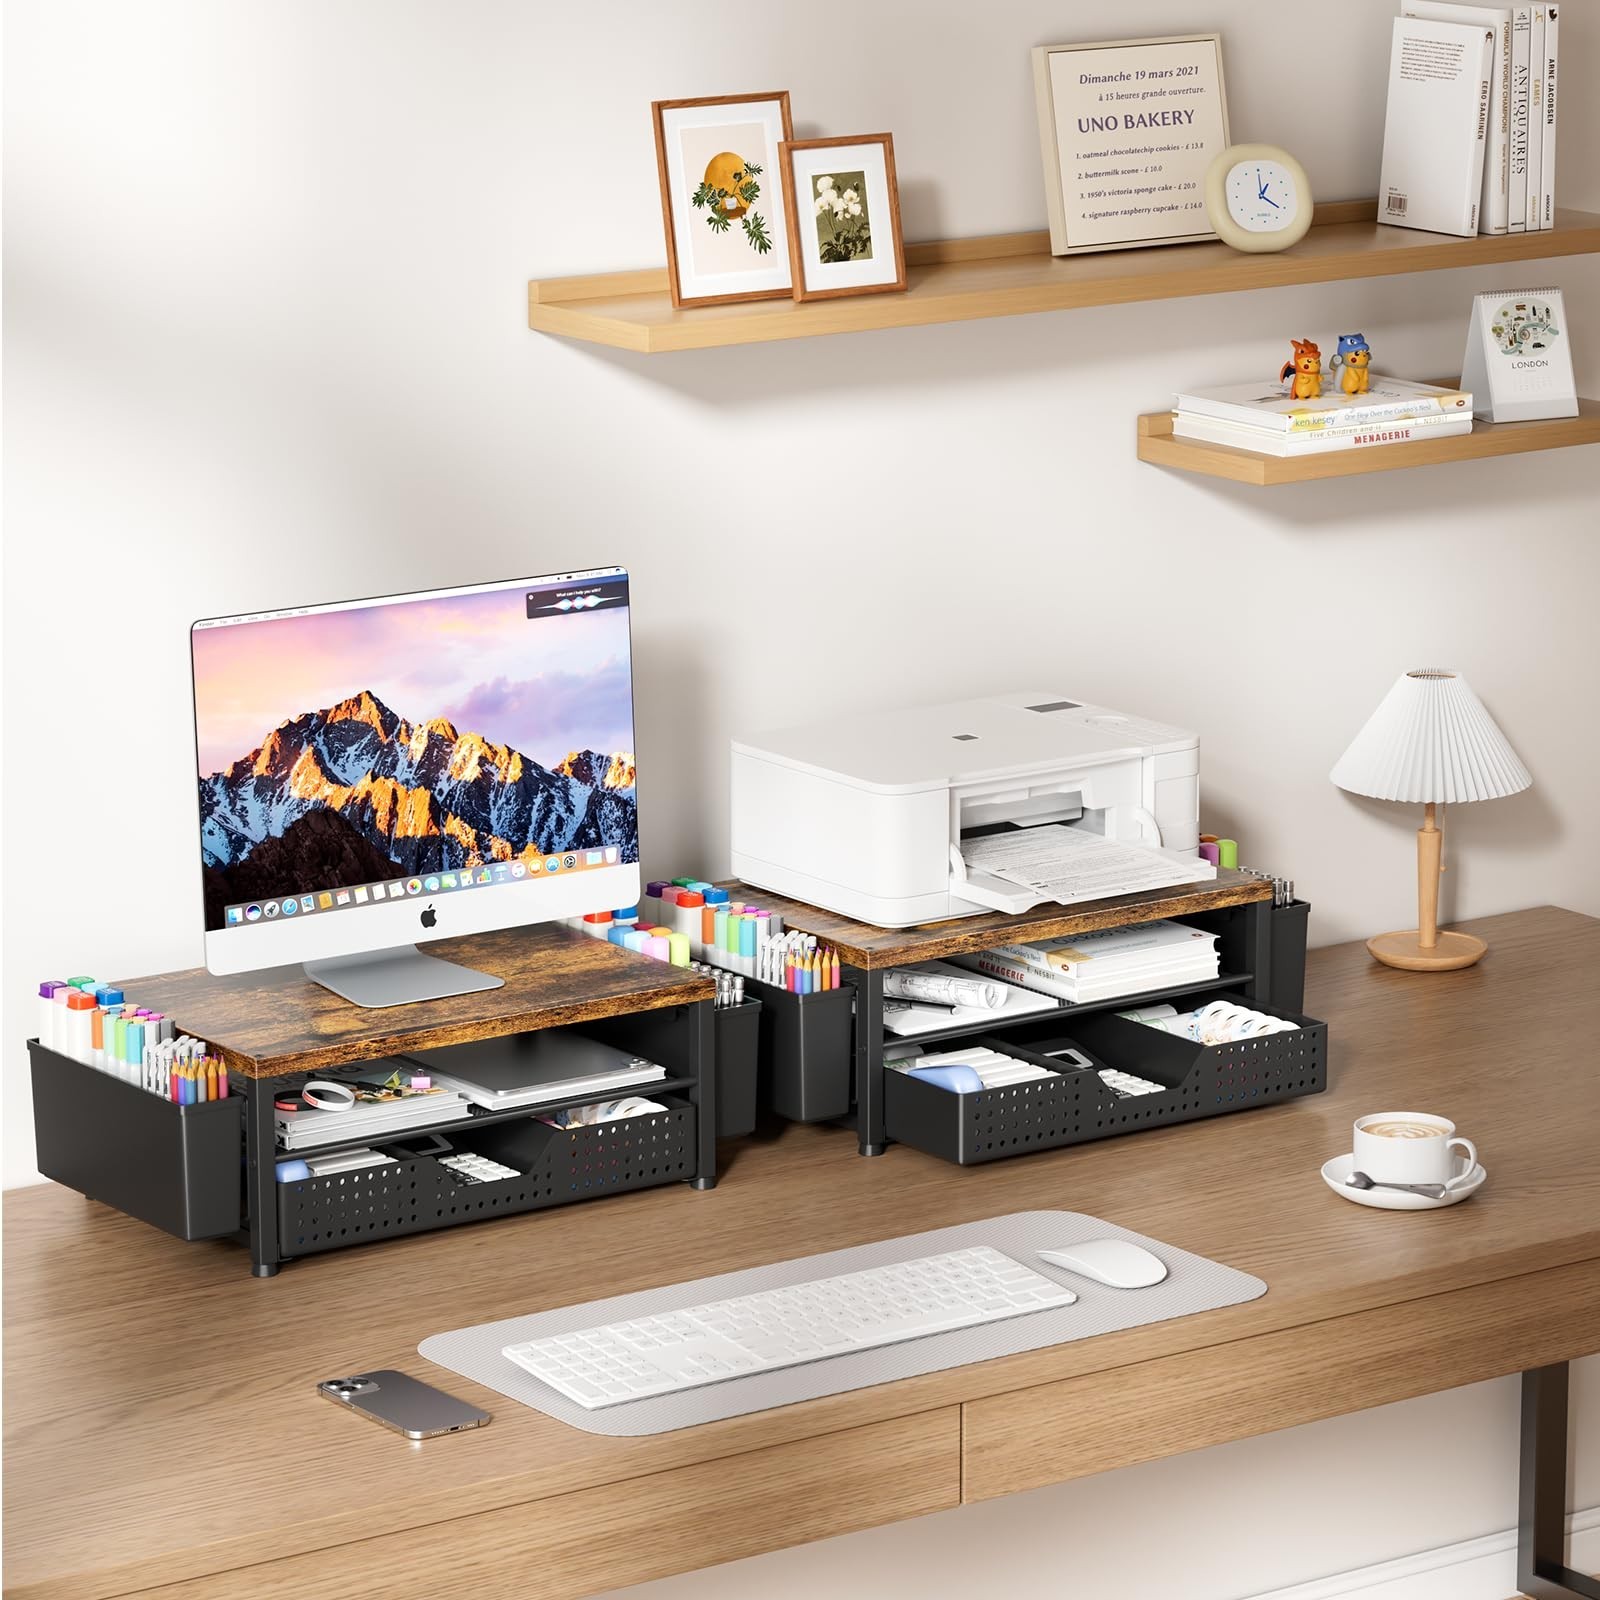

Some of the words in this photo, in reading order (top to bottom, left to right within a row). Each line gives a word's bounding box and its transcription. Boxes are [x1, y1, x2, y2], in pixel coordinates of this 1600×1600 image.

[1079, 71, 1132, 85] Dimanche
[1135, 70, 1146, 80] 19
[1149, 68, 1174, 79] mars
[1176, 65, 1199, 77] 2021
[1105, 93, 1114, 101] 15
[1116, 91, 1140, 100] heures
[1141, 88, 1166, 100] grande
[1168, 86, 1206, 96] ouverture.
[1078, 115, 1118, 133] UNO
[1124, 109, 1195, 129] BAKERY
[1477, 102, 1487, 140] SAARINEN
[1516, 65, 1528, 174] ANTIQUAIRES
[1082, 150, 1109, 159] oatmeal
[1110, 146, 1154, 157] chocolatechip
[1155, 144, 1180, 152] cookies
[1084, 168, 1119, 179] buttermilk
[1120, 167, 1139, 175] scone
[1087, 189, 1107, 199] 1950's
[1108, 187, 1133, 197] victoria
[1134, 185, 1156, 195] sponge
[1157, 182, 1172, 191] cake
[1183, 182, 1196, 190] 20.0
[1088, 210, 1119, 220] signature
[1120, 206, 1151, 217] raspberry
[1152, 204, 1179, 214] cupcake
[1190, 201, 1203, 209] 14.0
[1511, 360, 1549, 369] LONDON
[1295, 418, 1310, 427] ken
[1312, 415, 1336, 425] kesey
[1327, 428, 1357, 436] Children
[1354, 429, 1410, 445] MENAGERIE
[1009, 947, 1030, 959] Cuckoo's
[1030, 953, 1041, 962] Nest
[978, 960, 1025, 982] MENAGERIE
[1034, 968, 1056, 980] NESBIT
